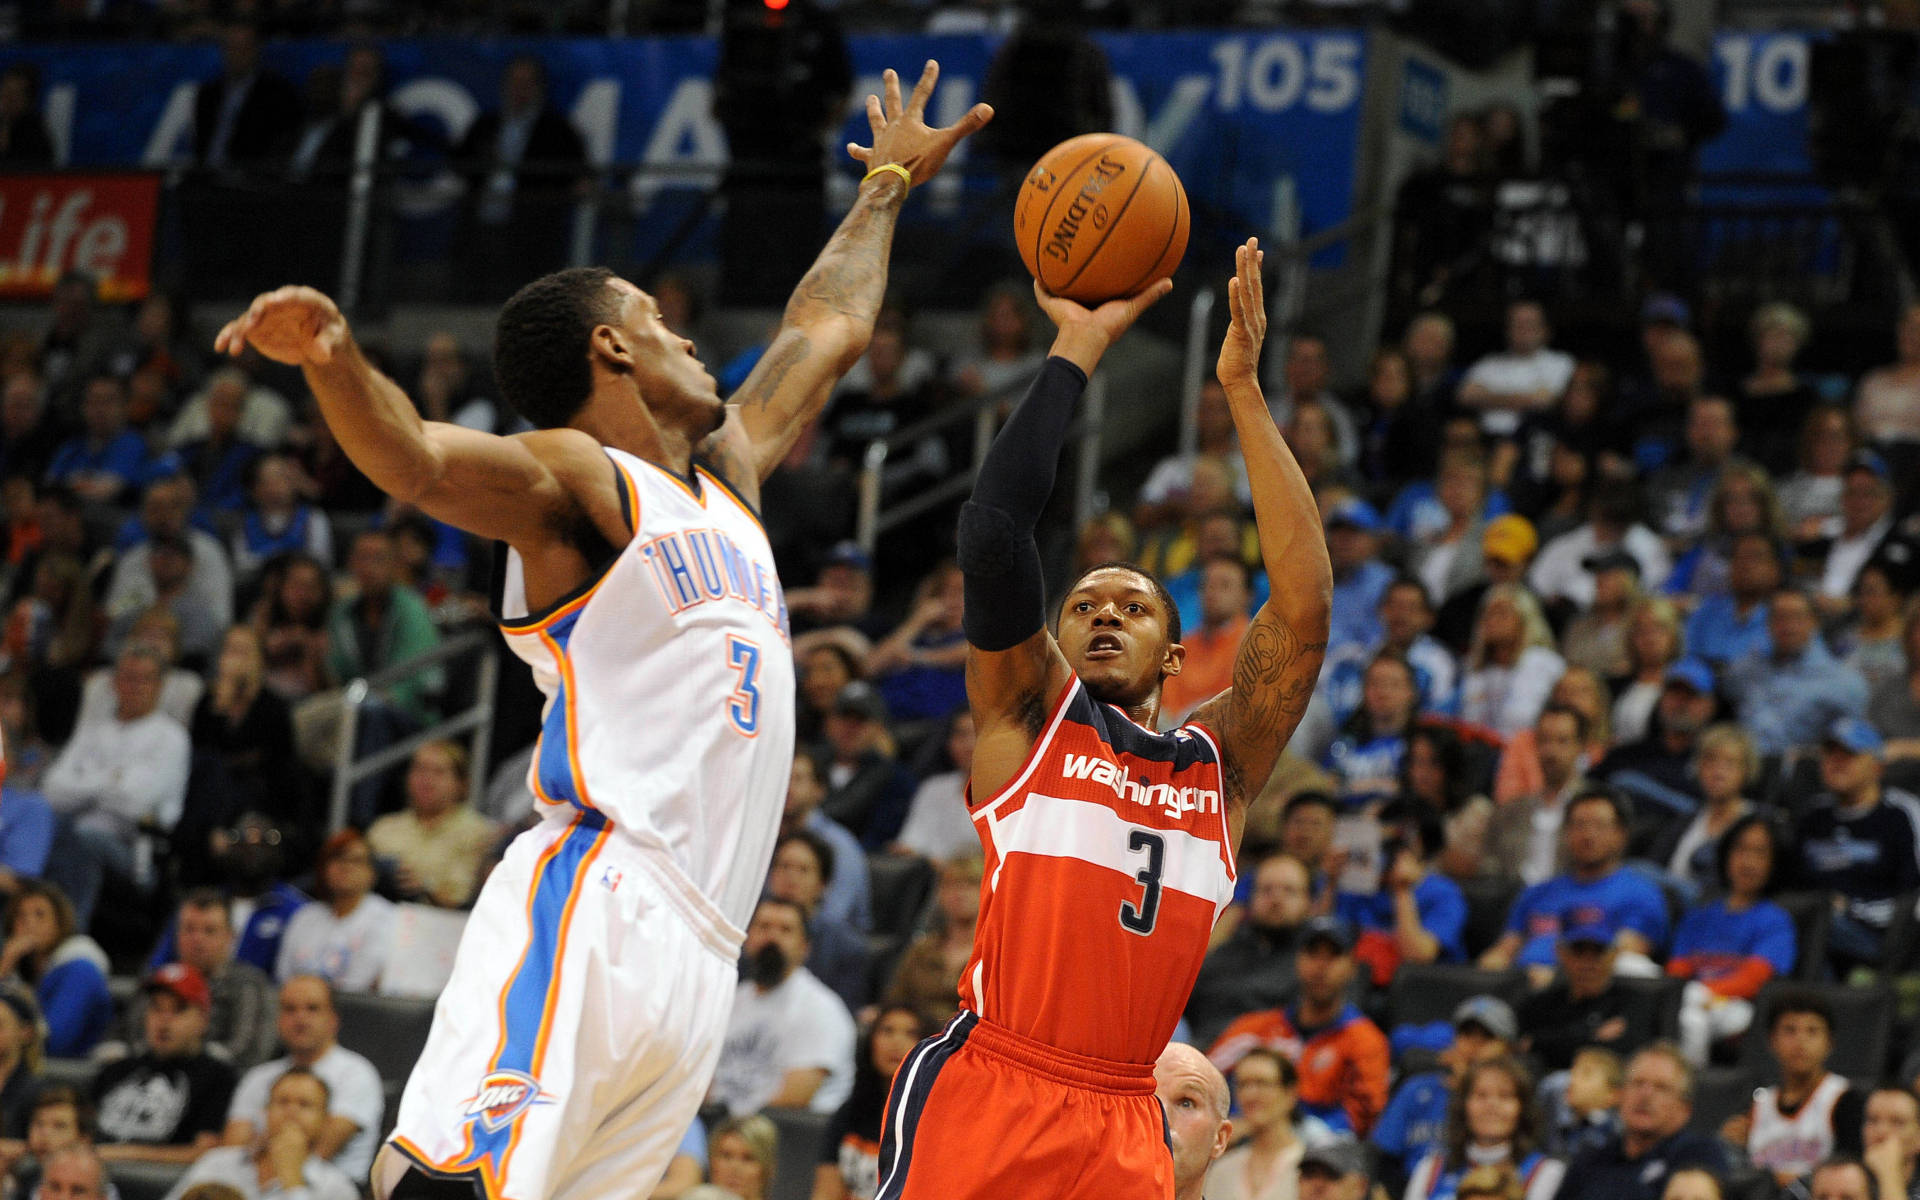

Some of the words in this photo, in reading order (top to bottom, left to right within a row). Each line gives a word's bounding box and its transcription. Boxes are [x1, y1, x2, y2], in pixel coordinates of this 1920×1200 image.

[1210, 39, 1360, 112] 105
[1042, 154, 1125, 264] SPALDING
[726, 632, 762, 738] 3
[1119, 825, 1167, 937] 3
[463, 1084, 529, 1116] OKC
